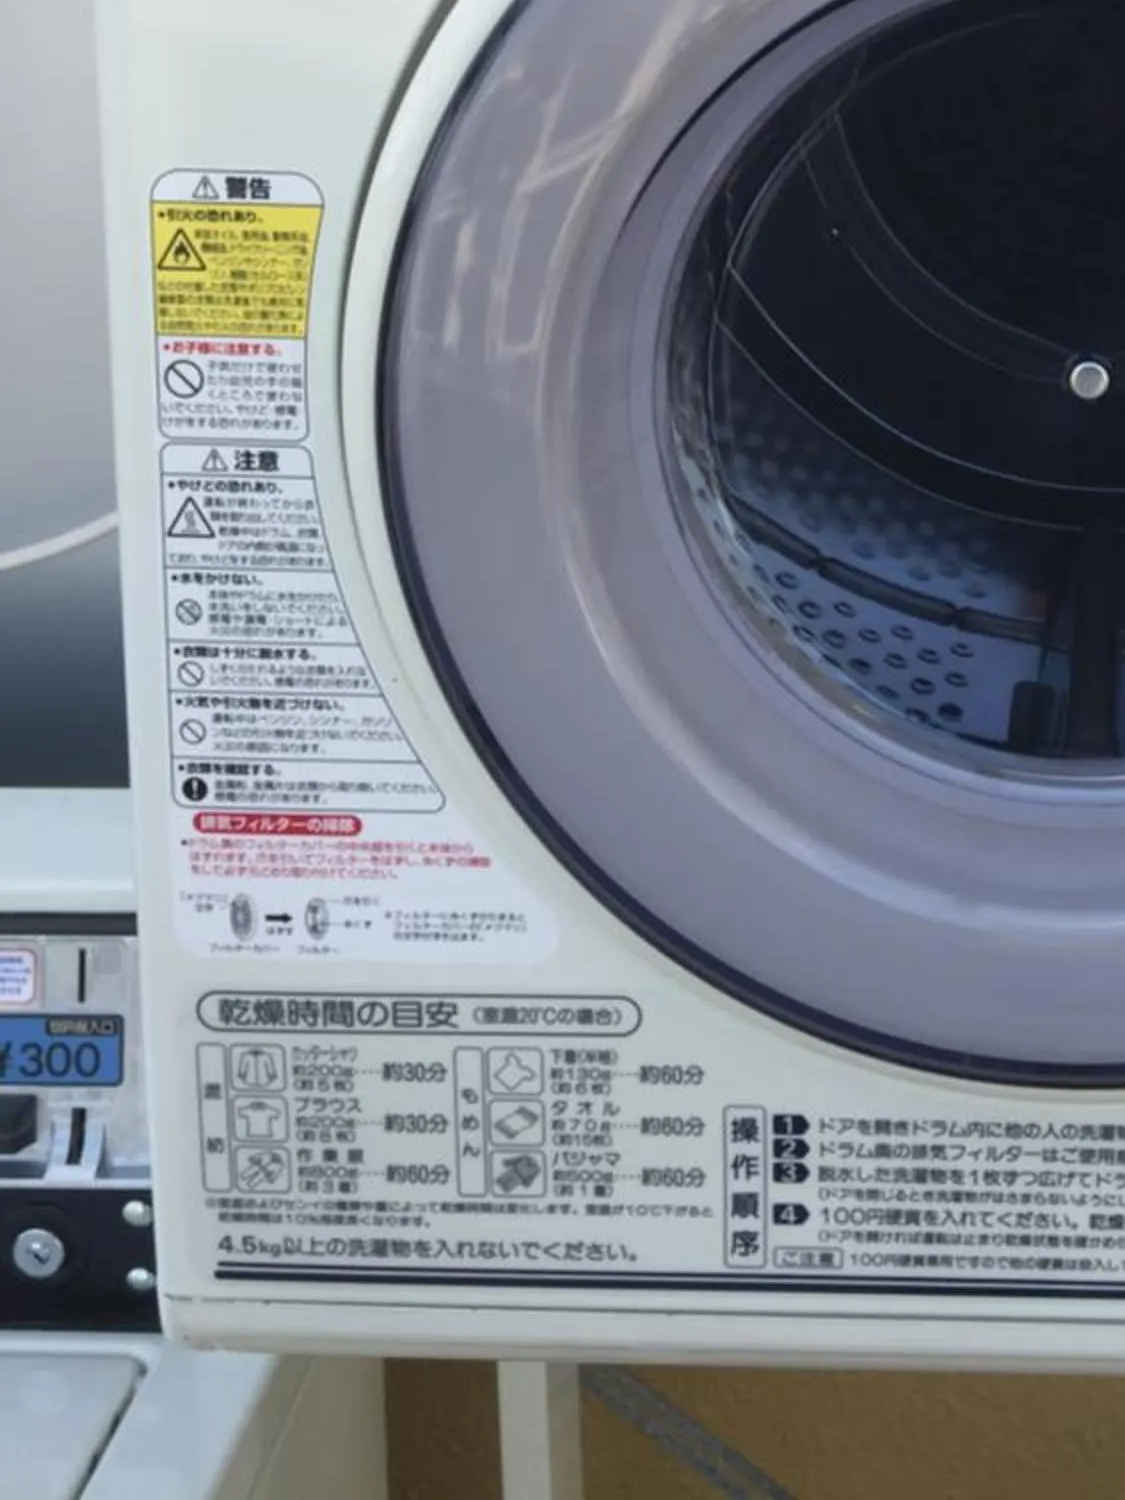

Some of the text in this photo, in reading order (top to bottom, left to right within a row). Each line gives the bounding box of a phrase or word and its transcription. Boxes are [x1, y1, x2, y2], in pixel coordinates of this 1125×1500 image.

[225, 176, 272, 200] 警告
[234, 449, 279, 472] 注意
[218, 997, 459, 1029] 乾燥時間の目安
[780, 1140, 797, 1159] 2
[780, 1164, 797, 1183] 3
[730, 1116, 761, 1258] 操作順序
[780, 1205, 797, 1223] 4
